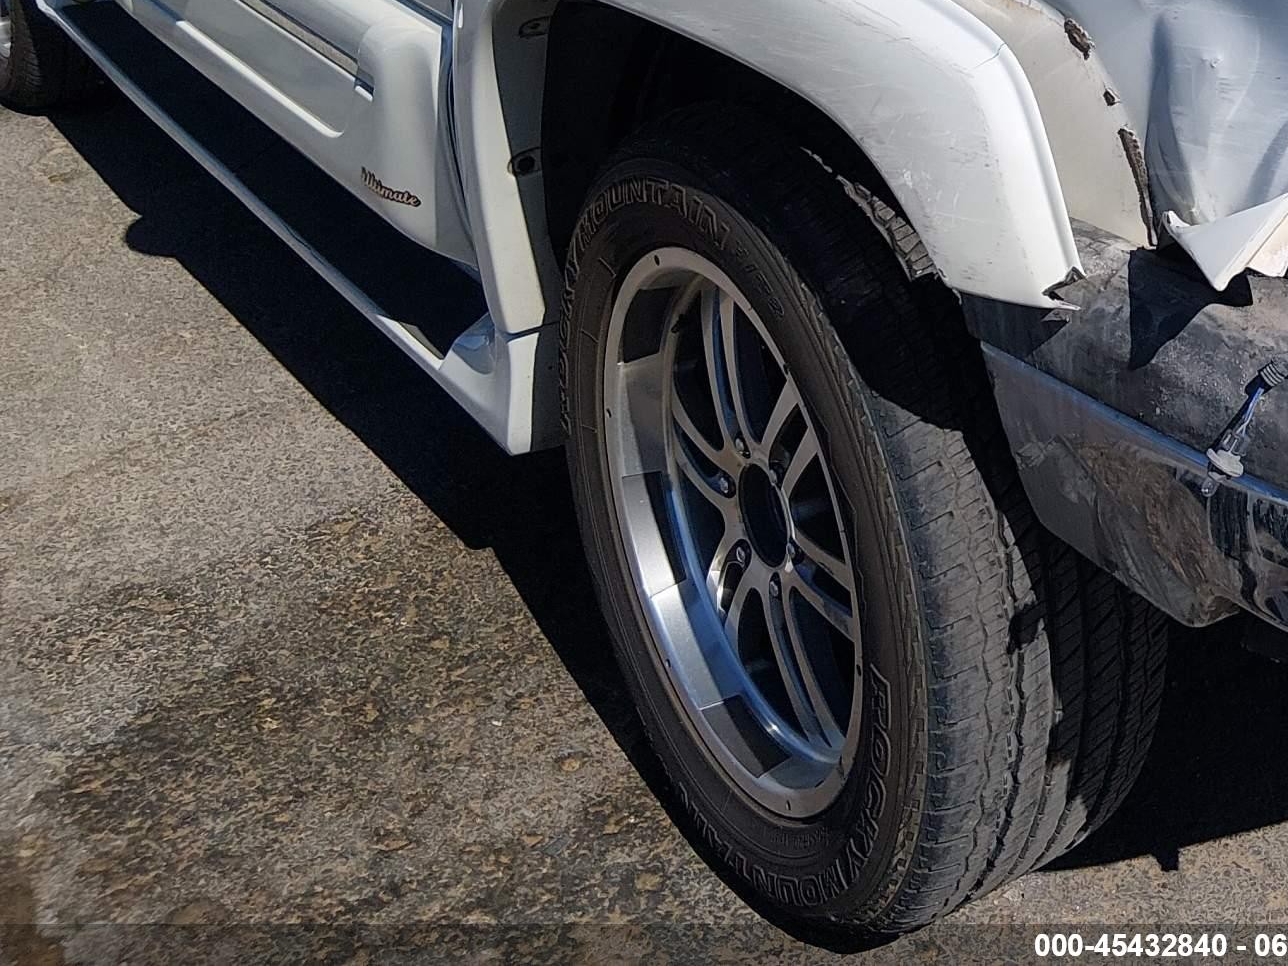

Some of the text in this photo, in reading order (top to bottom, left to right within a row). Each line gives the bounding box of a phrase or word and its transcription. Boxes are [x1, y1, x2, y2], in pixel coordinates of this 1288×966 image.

[361, 166, 422, 208] Ultimate
[576, 177, 731, 252] MOUNTAIN
[847, 663, 892, 881] ROCKY
